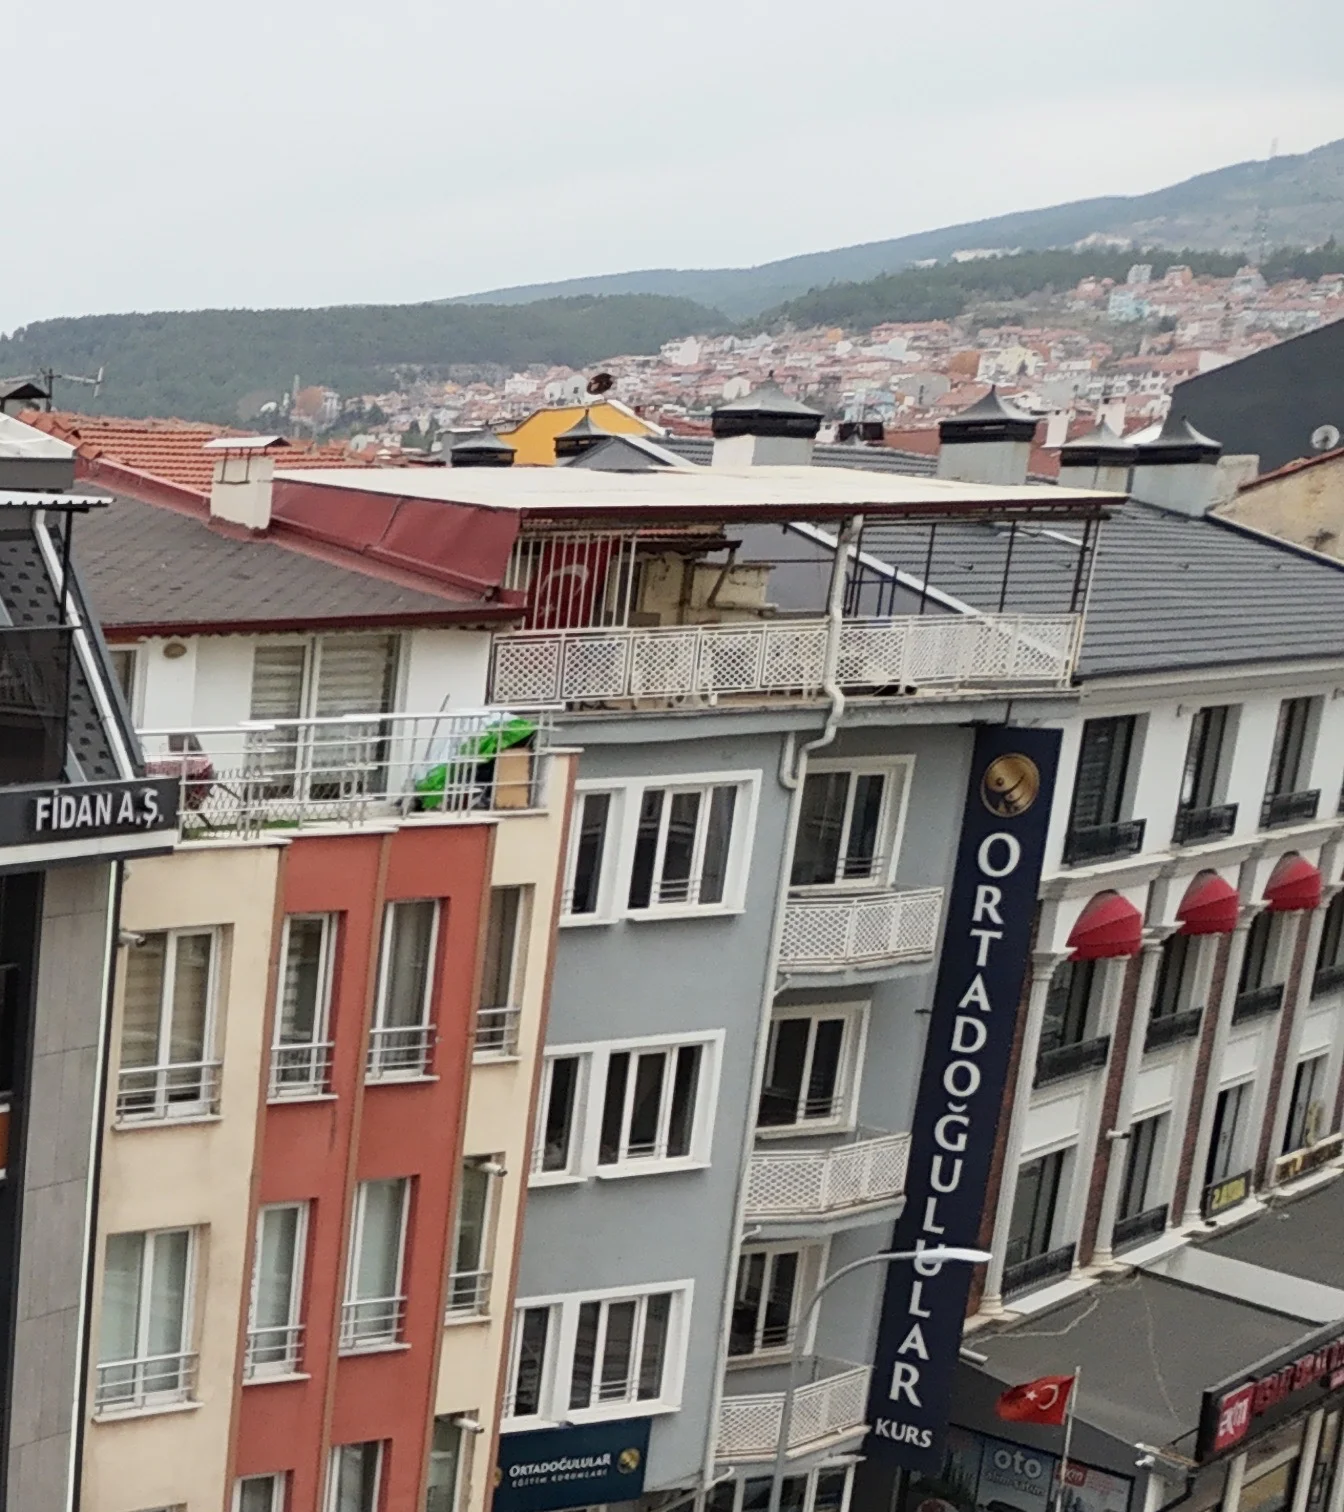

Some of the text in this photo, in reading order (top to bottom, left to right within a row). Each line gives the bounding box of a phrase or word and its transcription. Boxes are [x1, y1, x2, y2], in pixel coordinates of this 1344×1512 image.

[35, 787, 164, 831] FİDAN A.Ş.
[889, 832, 1022, 1409] ORTADOĞULULAR
[875, 1417, 933, 1449] KURS
[508, 1453, 612, 1478] ORTADOĞULULAR
[993, 1448, 1043, 1479] oto
